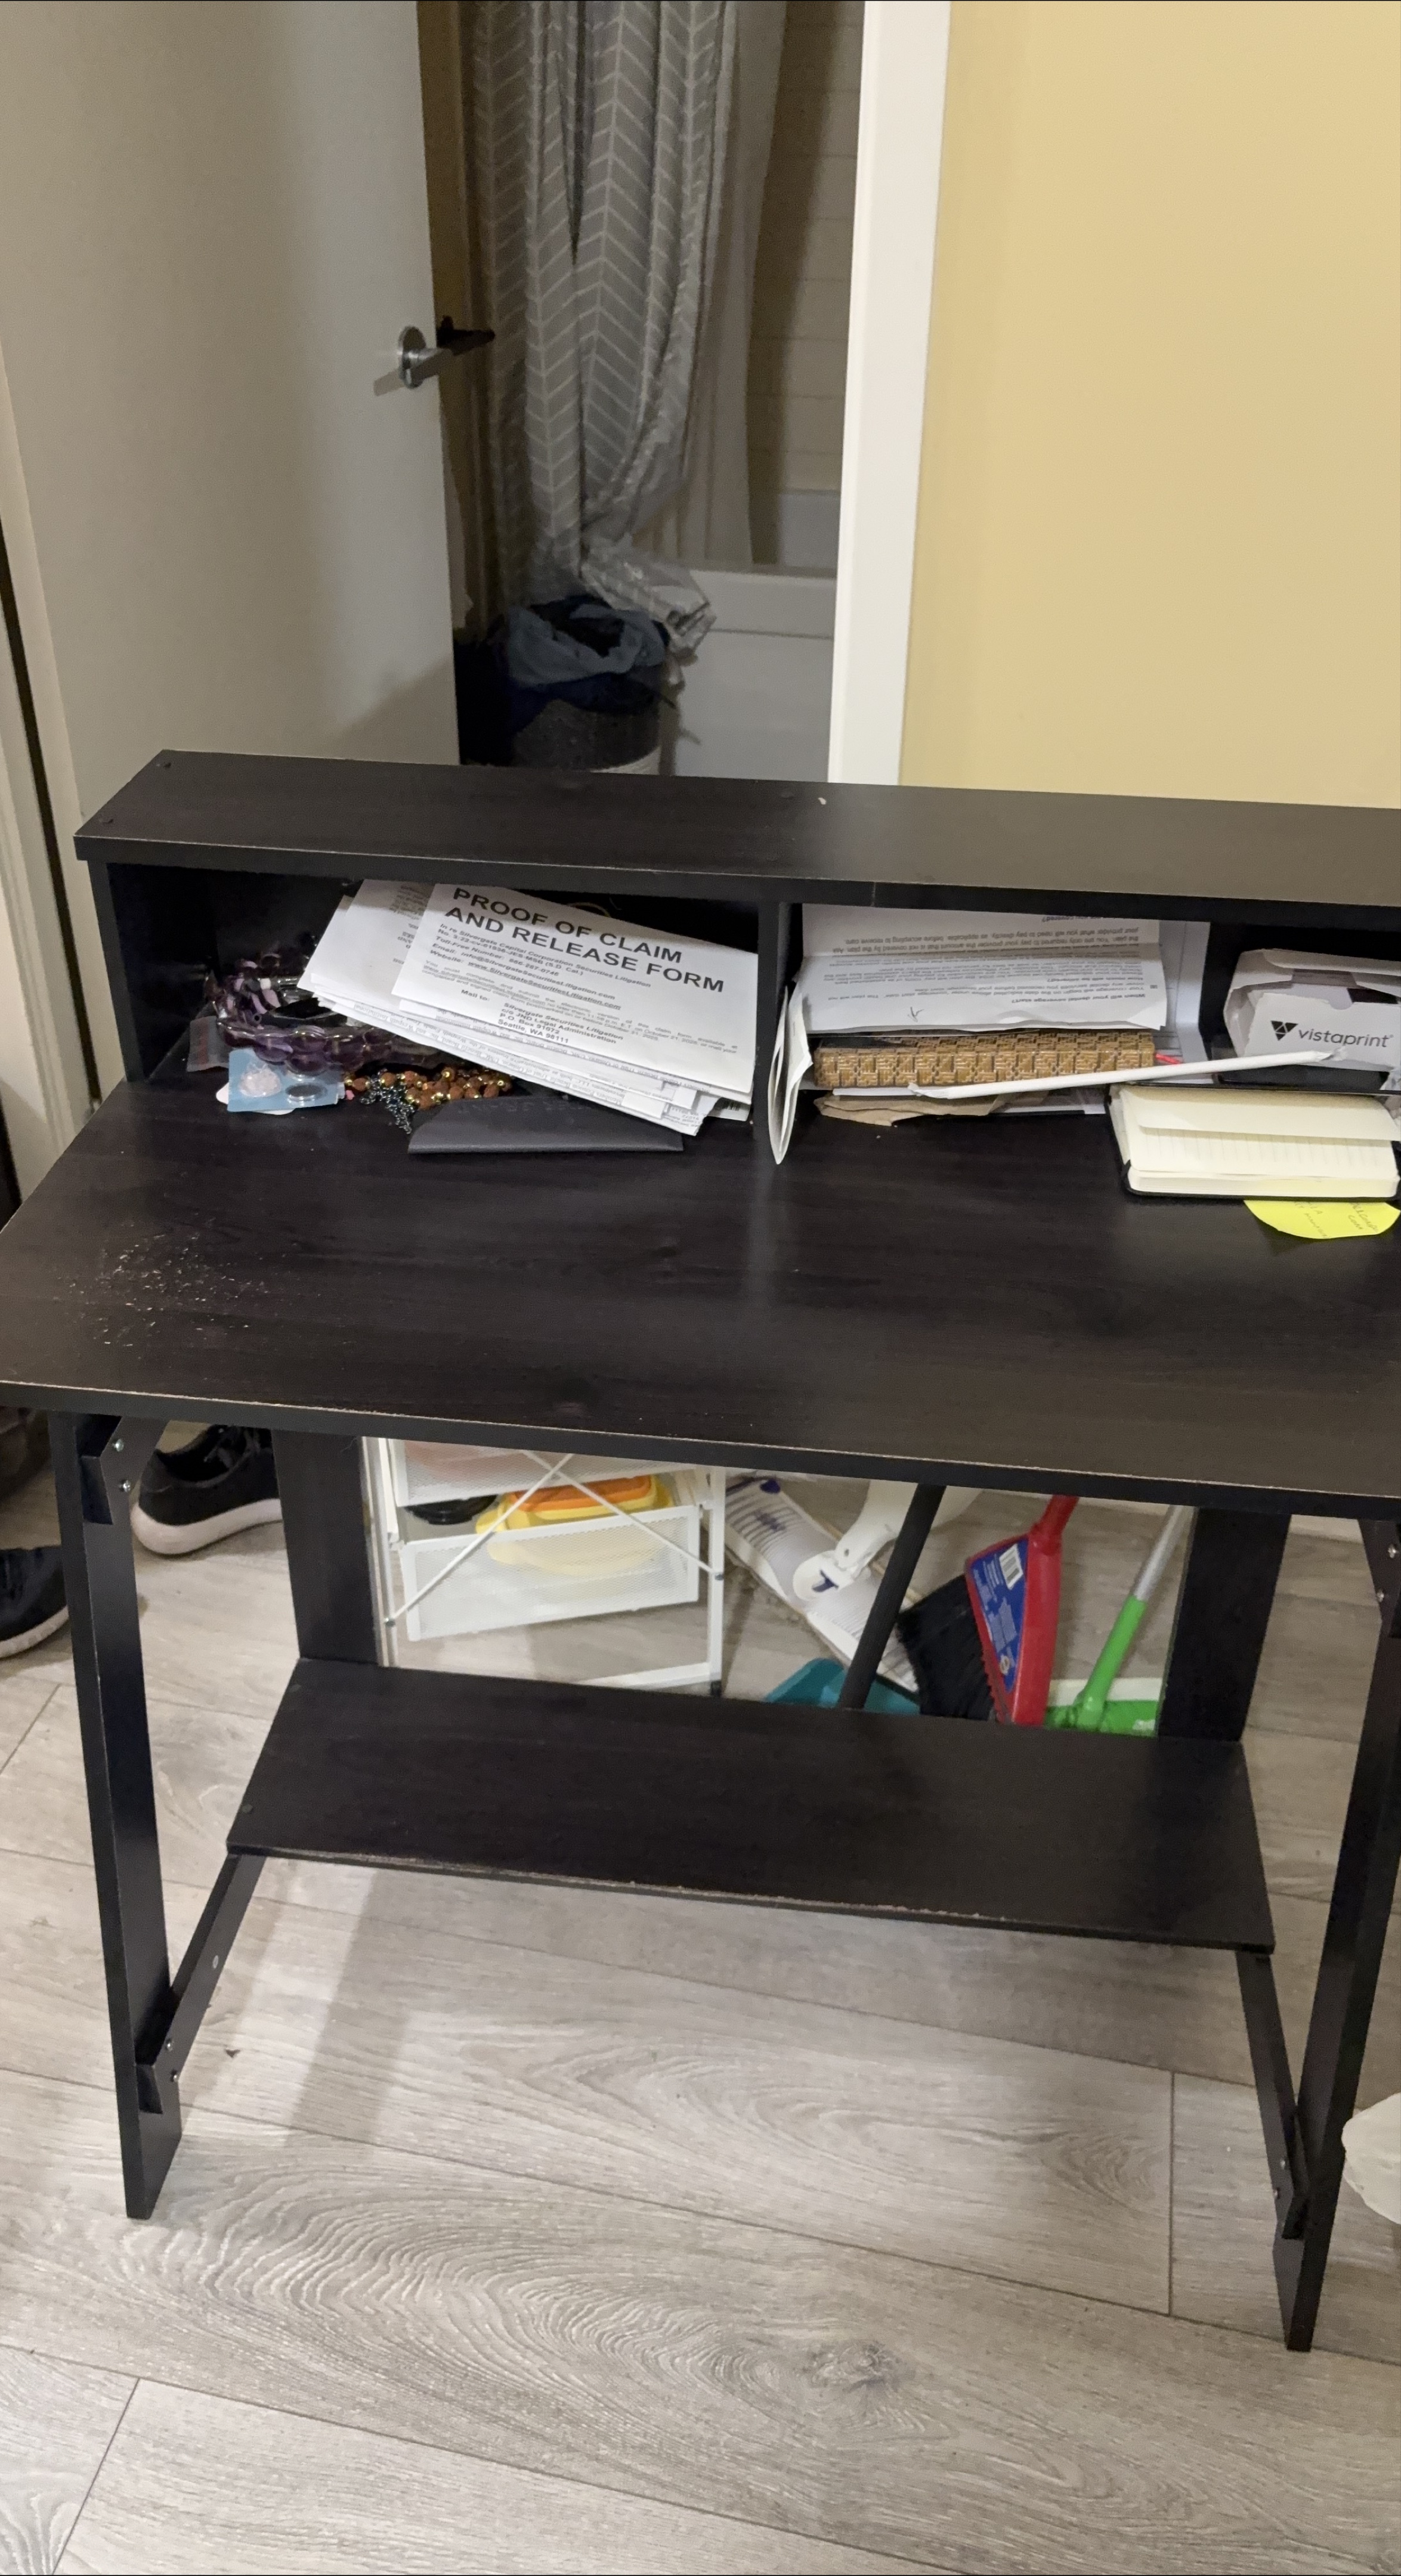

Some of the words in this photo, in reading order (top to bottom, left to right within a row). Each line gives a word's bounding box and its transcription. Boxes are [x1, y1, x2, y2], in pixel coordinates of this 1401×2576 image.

[453, 888, 548, 925] PROOF
[555, 921, 592, 937] OF
[600, 933, 681, 963] CLAIM
[429, 949, 464, 964] Website:
[432, 943, 457, 954] Email:
[435, 936, 470, 949] Toll-Free
[471, 947, 504, 959] Number:
[445, 908, 503, 932] AND
[512, 927, 638, 971] RELEASE
[647, 963, 723, 992] FORM
[459, 930, 497, 946] Silvergate
[499, 942, 527, 954] Capital
[527, 950, 573, 967] Corporation
[575, 964, 613, 978] Securities
[614, 974, 651, 988] Litigation
[460, 989, 478, 998] Mail
[497, 1018, 528, 1032] Seattle,
[529, 1028, 543, 1036] WA
[545, 1032, 569, 1044] 98111
[503, 1002, 543, 1019] Silvergate
[545, 1014, 584, 1029] Securities
[586, 1026, 624, 1041] Litigation
[515, 1012, 533, 1021] JND
[534, 1018, 556, 1028] Legal
[558, 1024, 616, 1044] Administration
[518, 1018, 534, 1027] Box
[1298, 1029, 1390, 1048] vistaprint
